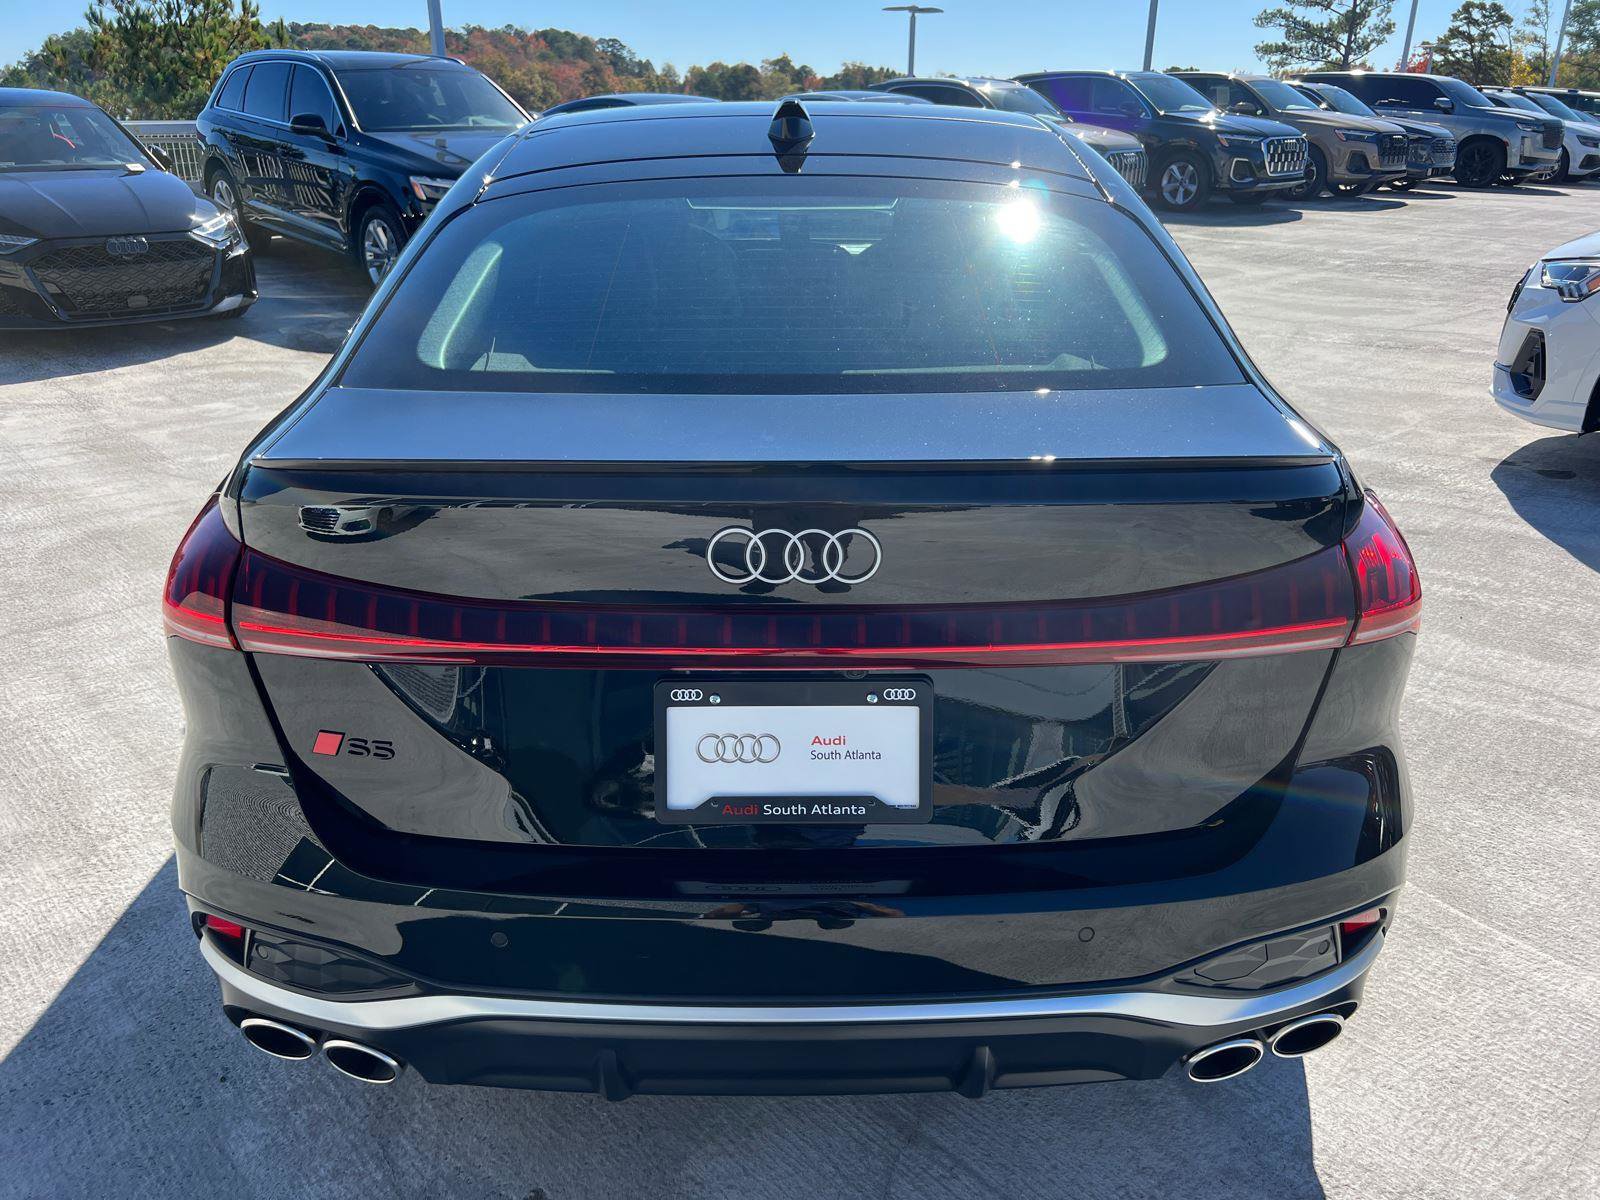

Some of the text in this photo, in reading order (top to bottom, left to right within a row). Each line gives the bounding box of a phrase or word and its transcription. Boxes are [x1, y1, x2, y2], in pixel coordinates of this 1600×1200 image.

[811, 735, 846, 746] Audi
[810, 749, 882, 760] South Atlanta
[722, 804, 866, 816] Audi South Atlanta
